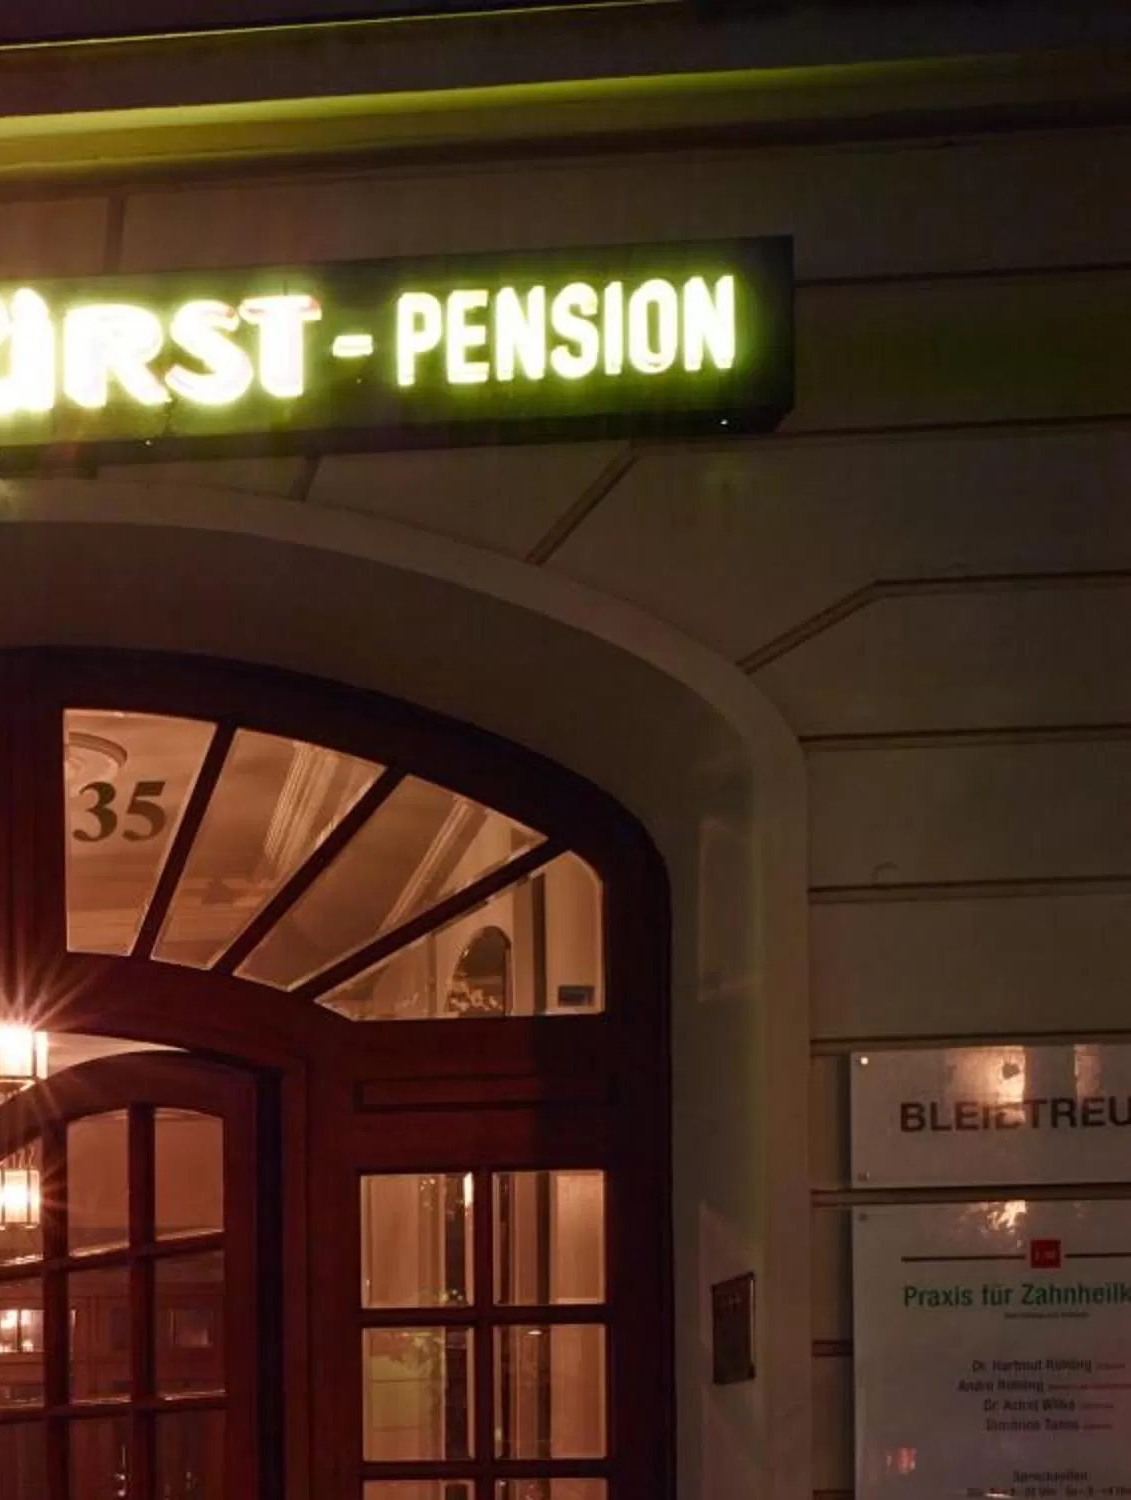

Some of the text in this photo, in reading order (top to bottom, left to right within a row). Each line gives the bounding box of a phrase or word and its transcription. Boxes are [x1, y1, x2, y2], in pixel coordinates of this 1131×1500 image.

[397, 276, 735, 386] PENSION
[72, 781, 168, 842] 35
[903, 1285, 974, 1307] Praxis
[982, 1283, 1014, 1306] für
